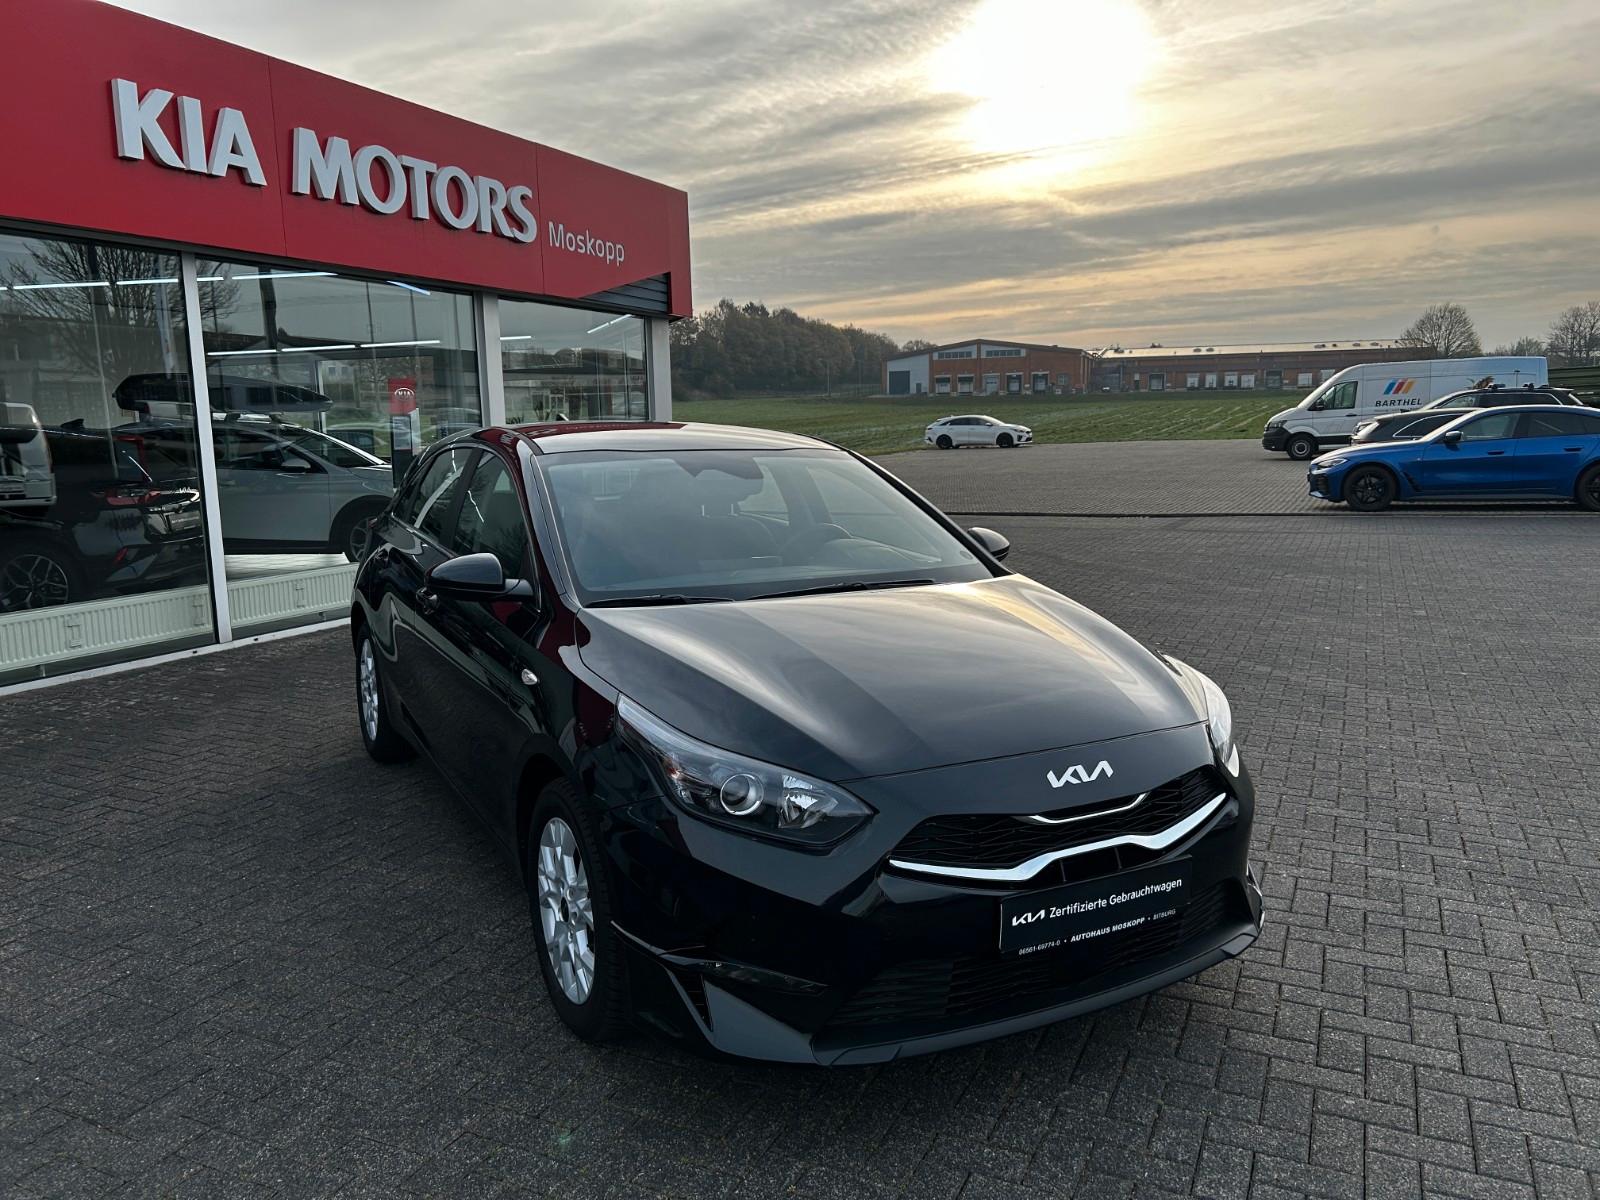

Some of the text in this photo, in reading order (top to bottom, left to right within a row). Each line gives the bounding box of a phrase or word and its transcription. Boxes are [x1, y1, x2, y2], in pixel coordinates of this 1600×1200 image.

[111, 78, 537, 243] KIA MOTORS
[548, 221, 625, 266] Moskopp
[1375, 398, 1423, 407] BARTHEL
[1046, 760, 1114, 788] KIA
[1049, 899, 1108, 918] Zertifizierte
[1109, 878, 1182, 906] Gebrauchtwagen
[1070, 926, 1111, 942] AUTOHAUS
[1111, 917, 1146, 932] MOSKOPP
